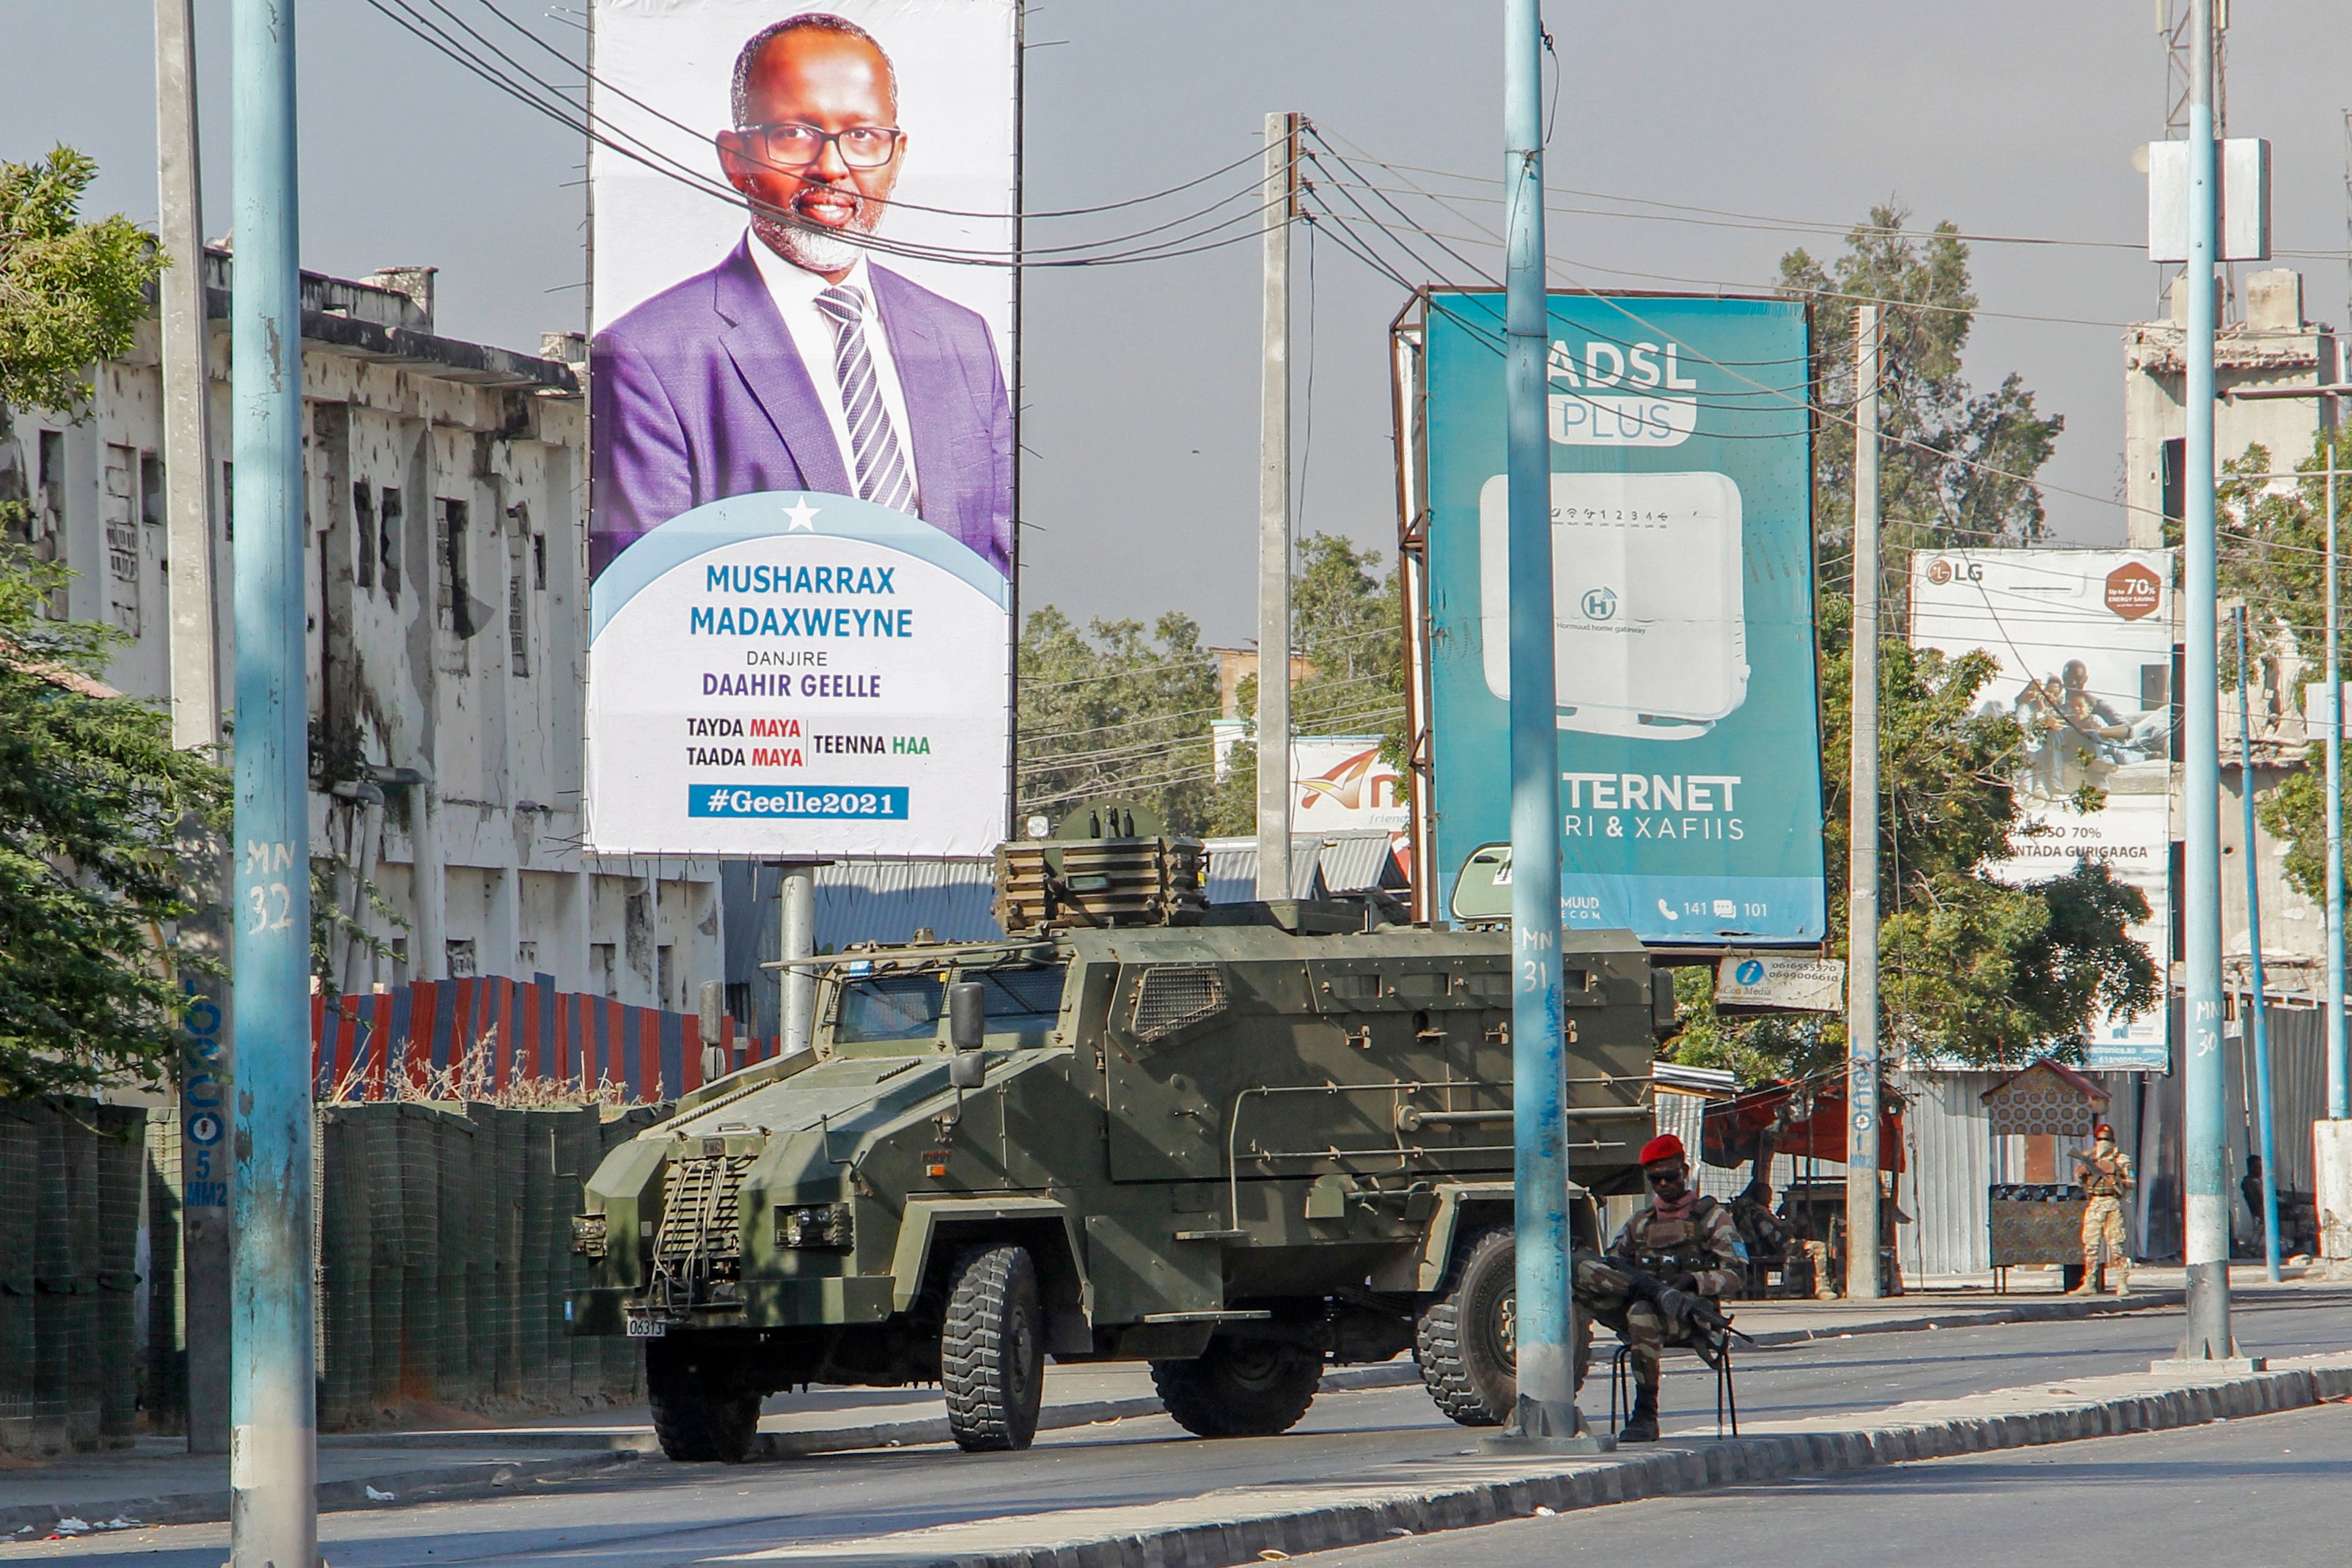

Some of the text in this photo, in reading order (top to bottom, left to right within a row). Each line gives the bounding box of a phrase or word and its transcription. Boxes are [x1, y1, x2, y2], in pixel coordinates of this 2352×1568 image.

[1548, 340, 1697, 389] ADSL
[1564, 402, 1671, 439] PLUS
[706, 565, 895, 594] MUSHARRAX
[1955, 563, 1983, 581] LG
[690, 607, 913, 638] MADAXWEYNE
[1557, 622, 1646, 635] Hormuud home gateway
[746, 650, 828, 666] DANJIRE
[702, 673, 881, 698] DAAHIR GEELLE
[687, 718, 801, 737] TAYDA MAYA
[814, 735, 930, 754] TEENNA HAA
[687, 748, 803, 767] TAADA MAYA
[708, 789, 894, 814] #Geelle2021
[1606, 816, 1624, 837] &
[1635, 817, 1744, 841] XAFIIS
[2072, 827, 2102, 839] 70%
[249, 883, 293, 935] 32
[1684, 902, 1767, 916] 141 101
[1522, 927, 1553, 951] MN
[1524, 960, 1546, 992] 31
[1743, 987, 1771, 995] Media
[2196, 1028, 2218, 1057] 30
